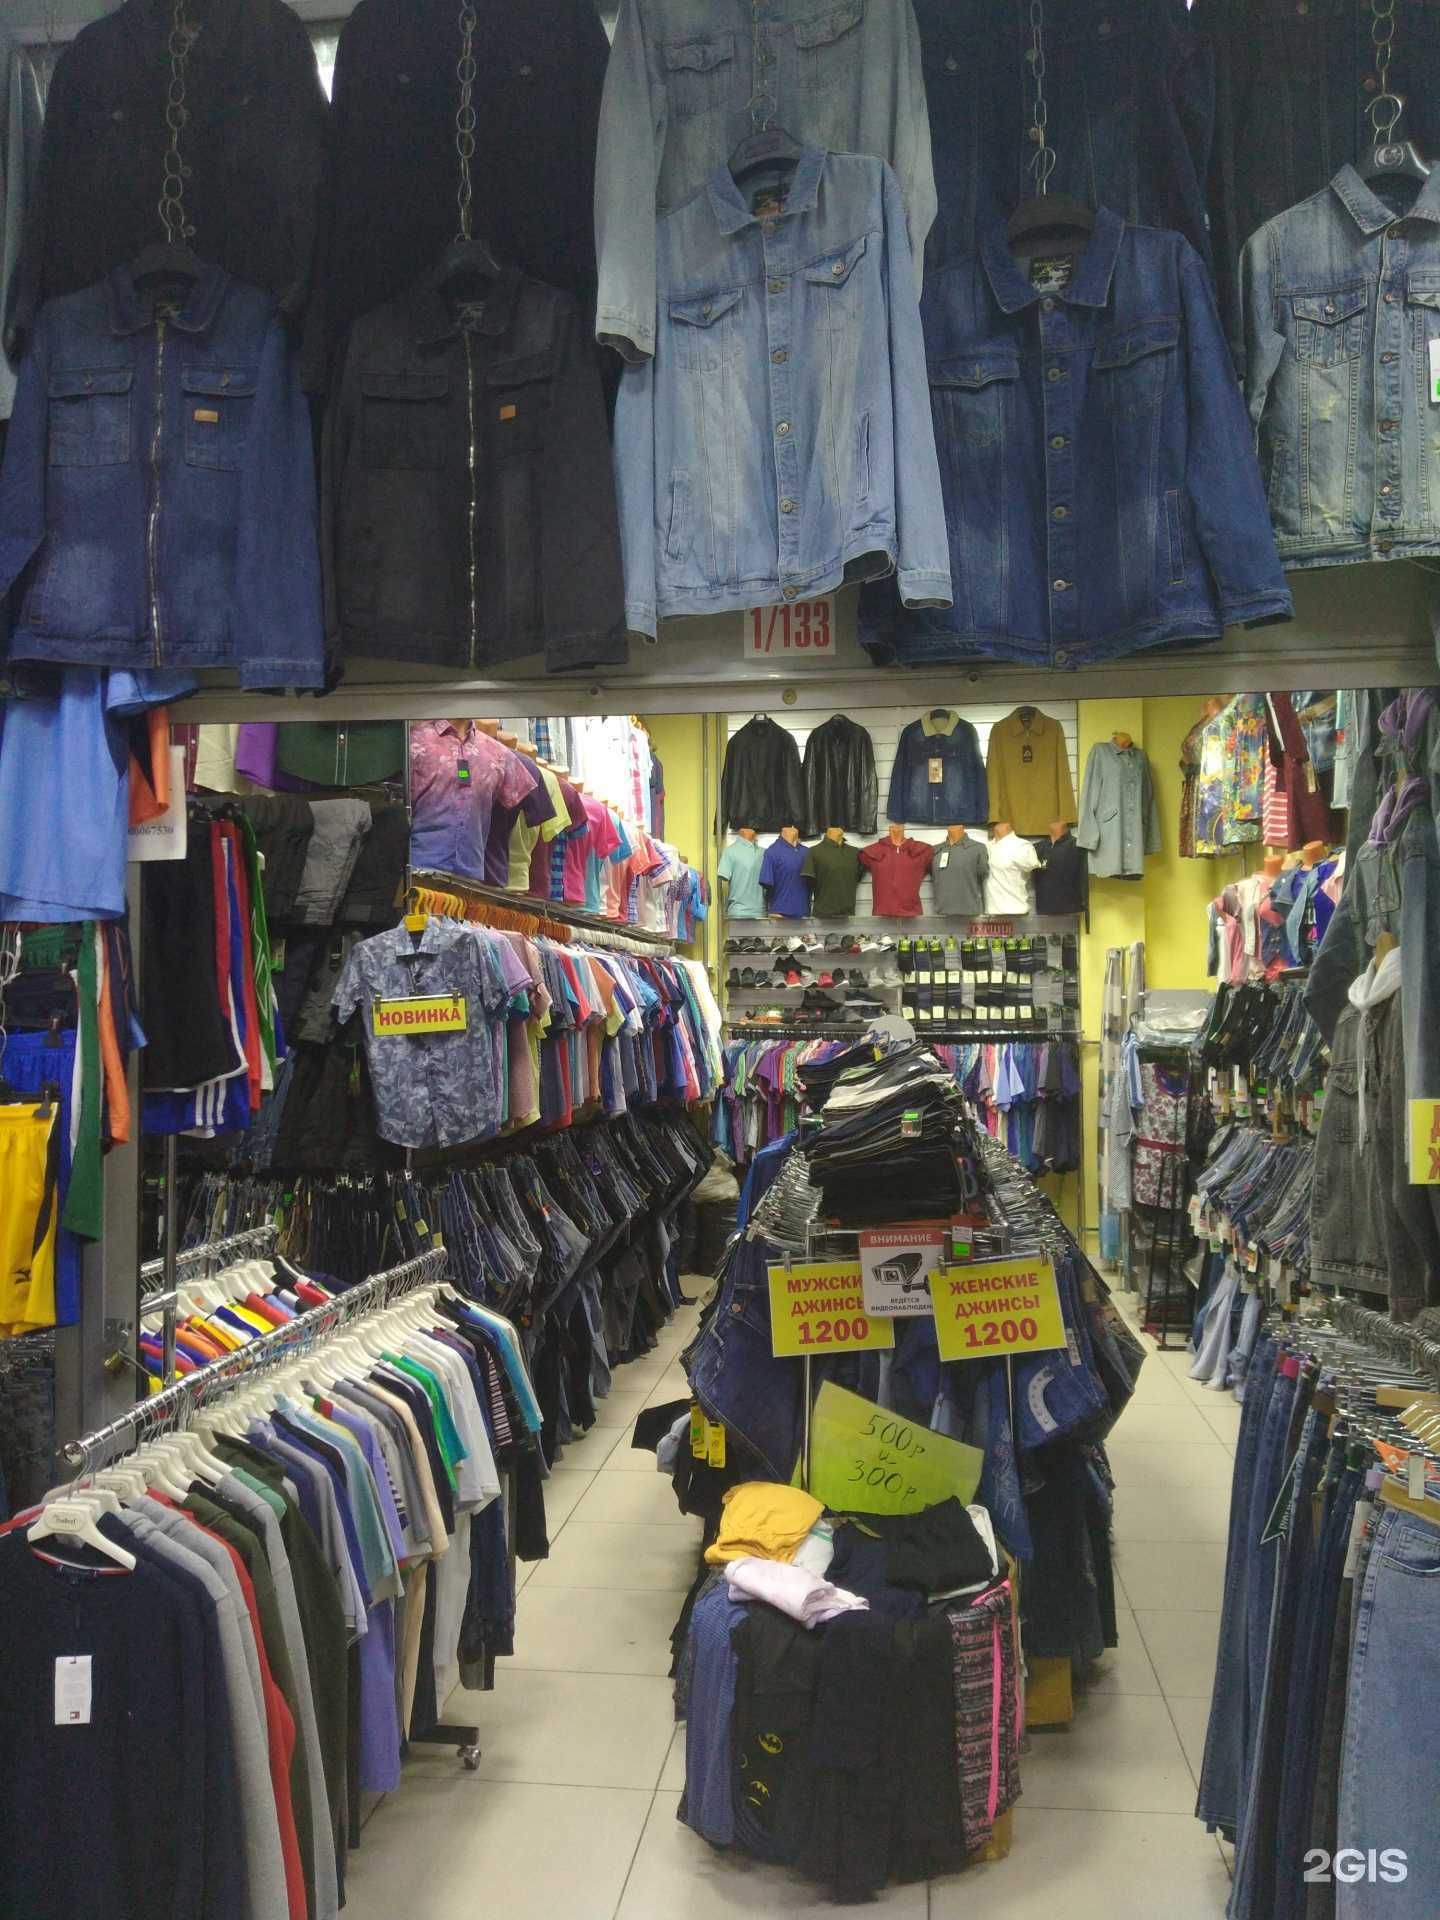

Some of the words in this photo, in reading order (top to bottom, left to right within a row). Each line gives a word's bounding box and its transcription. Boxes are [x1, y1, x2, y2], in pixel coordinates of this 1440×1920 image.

[750, 601, 829, 652] 1/133
[379, 1007, 461, 1026] НОВИНКА
[870, 1232, 933, 1245] ВНИМАНИЕ
[787, 1274, 864, 1294] МУЖСКИ
[949, 1272, 1040, 1297] ЖЕНСКИЕ
[954, 1294, 1041, 1320] ДЖИНСЫ
[798, 1317, 869, 1345] 1200
[964, 1317, 1038, 1348] 1200
